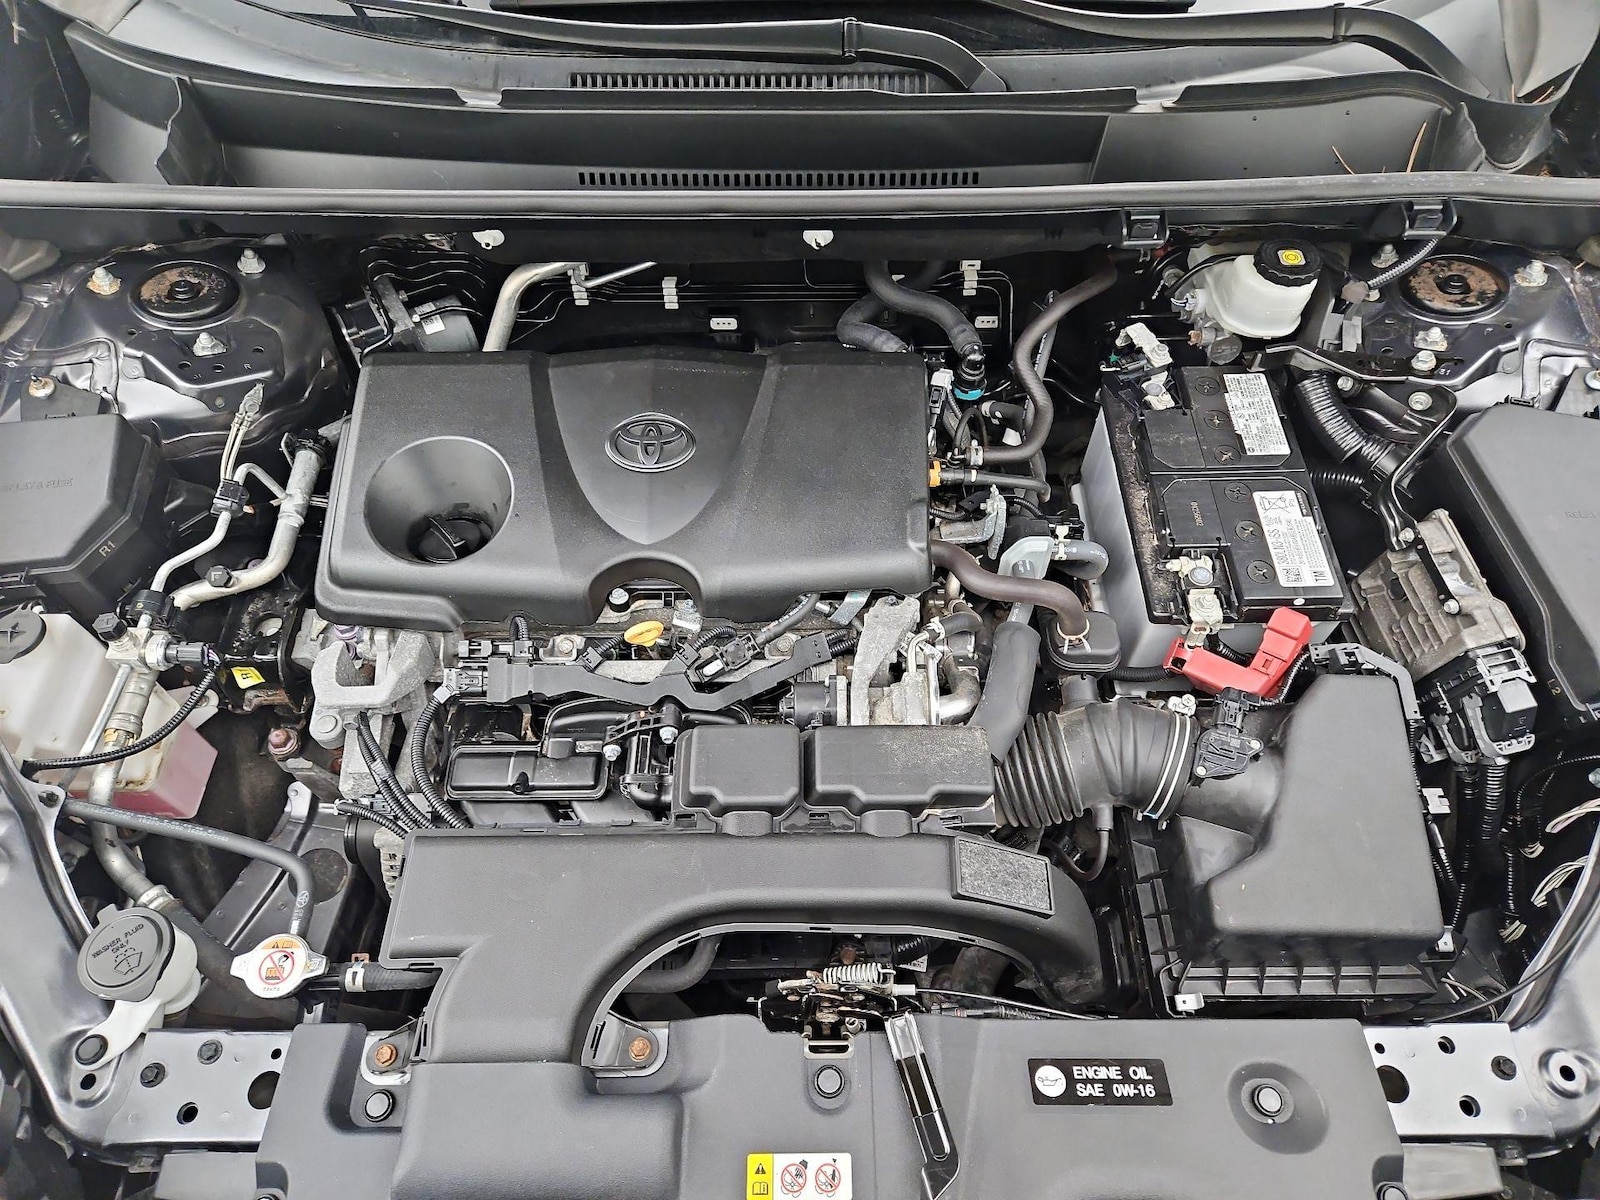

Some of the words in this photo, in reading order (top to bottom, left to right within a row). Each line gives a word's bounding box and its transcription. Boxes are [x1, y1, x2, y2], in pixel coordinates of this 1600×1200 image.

[1564, 510, 1600, 520] RELA
[99, 540, 116, 557] R1
[1547, 678, 1561, 696] L2
[92, 937, 121, 959] WASHER
[124, 923, 144, 939] FLUID
[111, 939, 129, 954] ONLY
[1072, 1065, 1123, 1080] ENGINE
[1129, 1065, 1153, 1080] OIL
[1076, 1083, 1105, 1098] SAE
[1112, 1083, 1156, 1098] 0W-16
